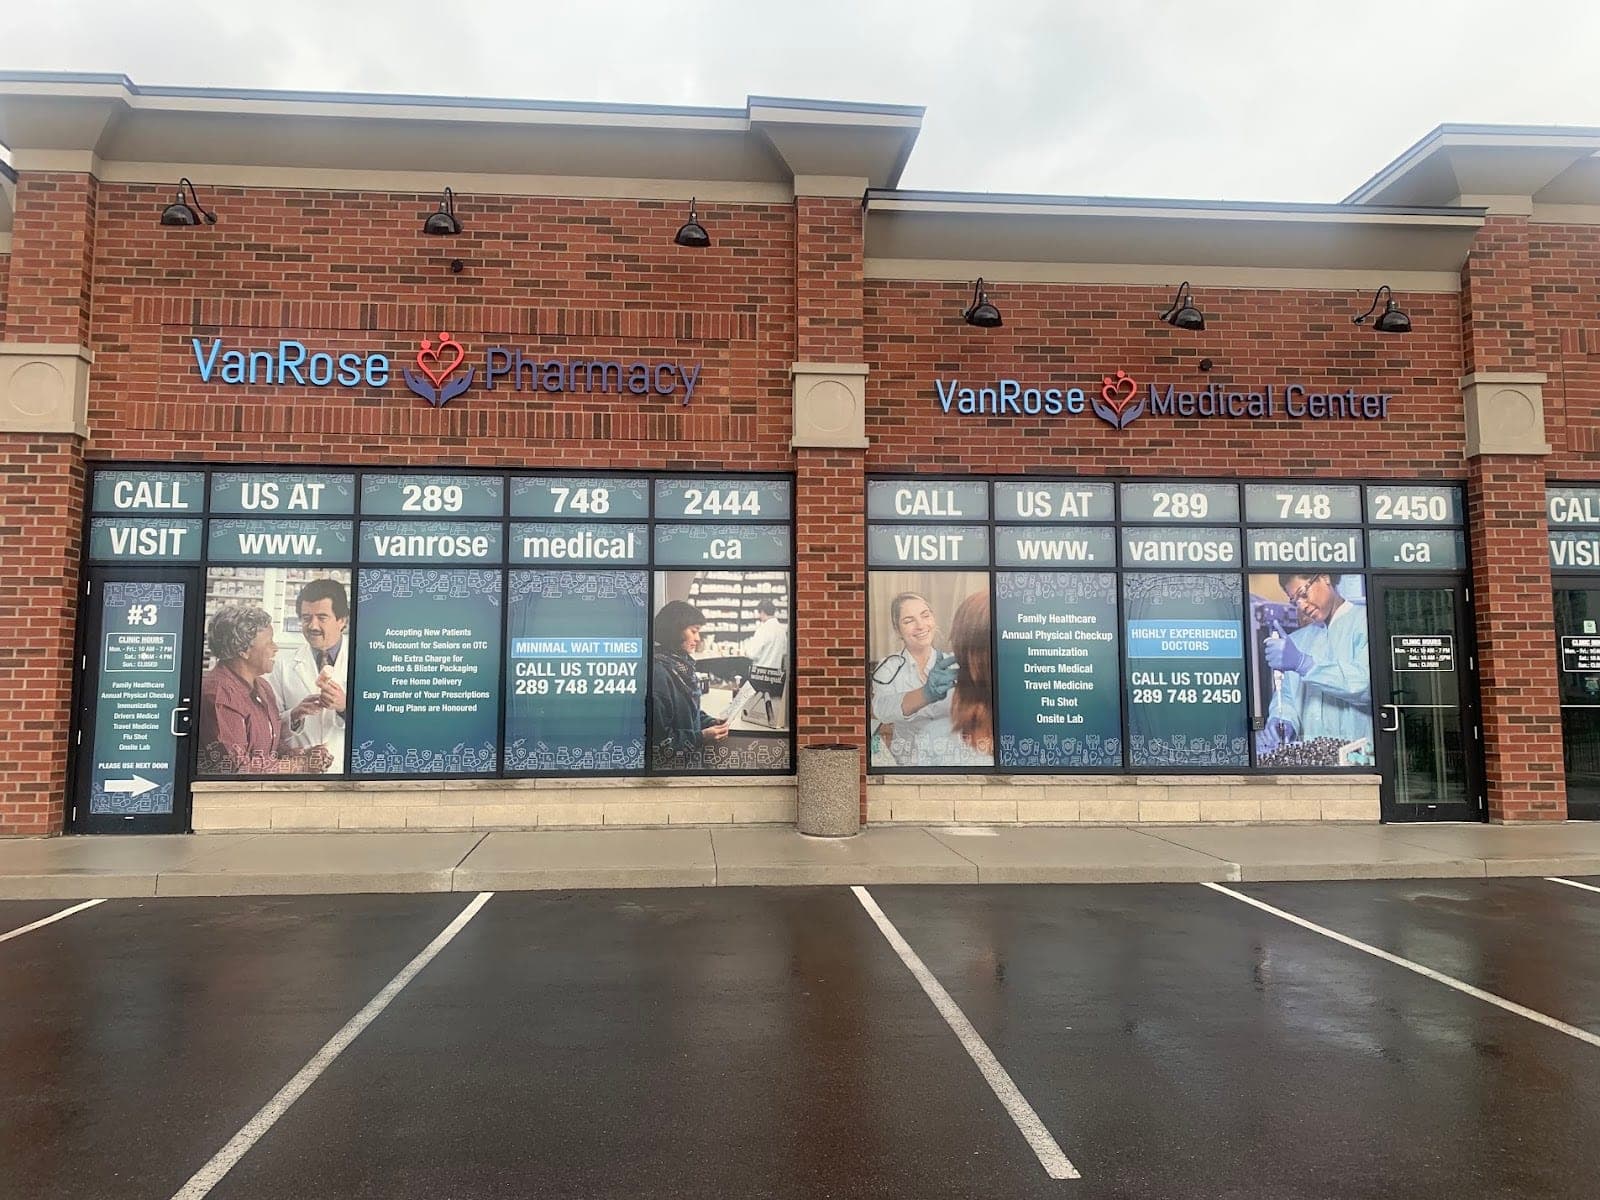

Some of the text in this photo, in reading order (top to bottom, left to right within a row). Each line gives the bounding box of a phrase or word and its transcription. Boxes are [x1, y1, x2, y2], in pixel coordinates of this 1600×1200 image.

[192, 338, 700, 406] VanRose Pharmacy
[935, 379, 1392, 419] VanRose Medical Center
[114, 480, 761, 515] CALL US AT 289 748 2444
[895, 489, 1447, 521] CALL US AT 289 748 2450
[1550, 496, 1600, 522] CAL
[109, 527, 742, 560] VISIT www. vanrose medical .ca
[894, 534, 1431, 563] VISIT www. vanrose medical .ca
[1550, 540, 1600, 566] VISI
[127, 604, 157, 626] #3
[1017, 614, 1097, 625] Family Healthcare
[385, 628, 422, 637] Accepting
[1001, 630, 1113, 641] Annual Physical Checkup
[1131, 628, 1238, 639] HIGHLY EXPERIENCED
[368, 641, 385, 649] 10%
[386, 641, 419, 649] Discount
[421, 641, 431, 649] for
[433, 641, 460, 649] Seniors
[473, 641, 488, 649] OTC
[515, 642, 638, 653] MINIMAL WAIT TIMES
[1161, 641, 1209, 651] DOCTORS
[1027, 647, 1089, 657] Immunization
[425, 655, 451, 663] Charge
[414, 664, 438, 672] Blister
[439, 664, 478, 673] Packaging
[515, 662, 638, 677] CALL US TODAY
[1024, 663, 1093, 673] Drivers Medical
[432, 678, 462, 686] Delivery
[1131, 672, 1240, 686] CALL US TODAY
[515, 679, 637, 694] 289 748 2444
[1024, 680, 1094, 690] Travel Medicine
[363, 691, 490, 700] Easy Transfer of Your Prescriptions
[1133, 689, 1242, 703] 289 748 2450
[1041, 697, 1078, 707] Flu Shot
[374, 704, 385, 712] All
[386, 704, 404, 713] Drug
[406, 704, 427, 712] Plans
[442, 704, 478, 712] Honoured
[1036, 714, 1084, 723] Onsite Lab
